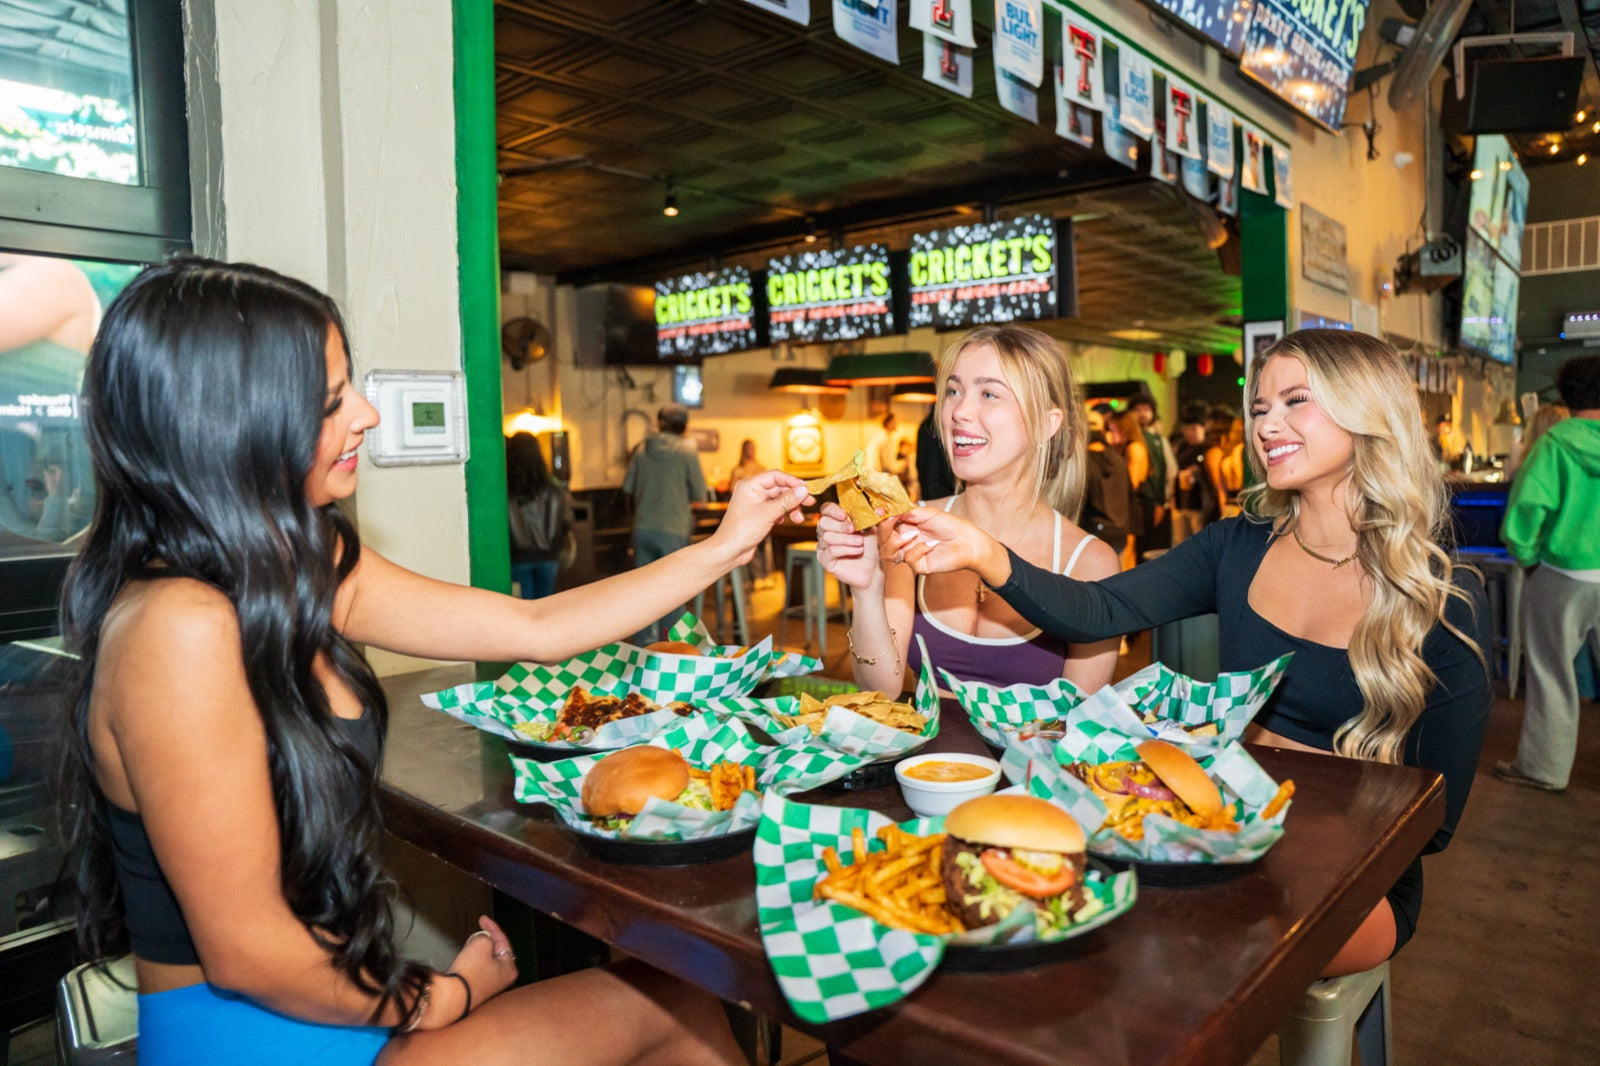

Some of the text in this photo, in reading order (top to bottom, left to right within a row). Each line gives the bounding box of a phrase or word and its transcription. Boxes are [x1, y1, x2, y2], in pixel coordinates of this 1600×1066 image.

[1001, 16, 1037, 49] LIGHT
[910, 234, 1052, 287] CRICKET'S
[655, 282, 751, 325] CRICKET'S
[768, 261, 888, 306] CRICKET'S
